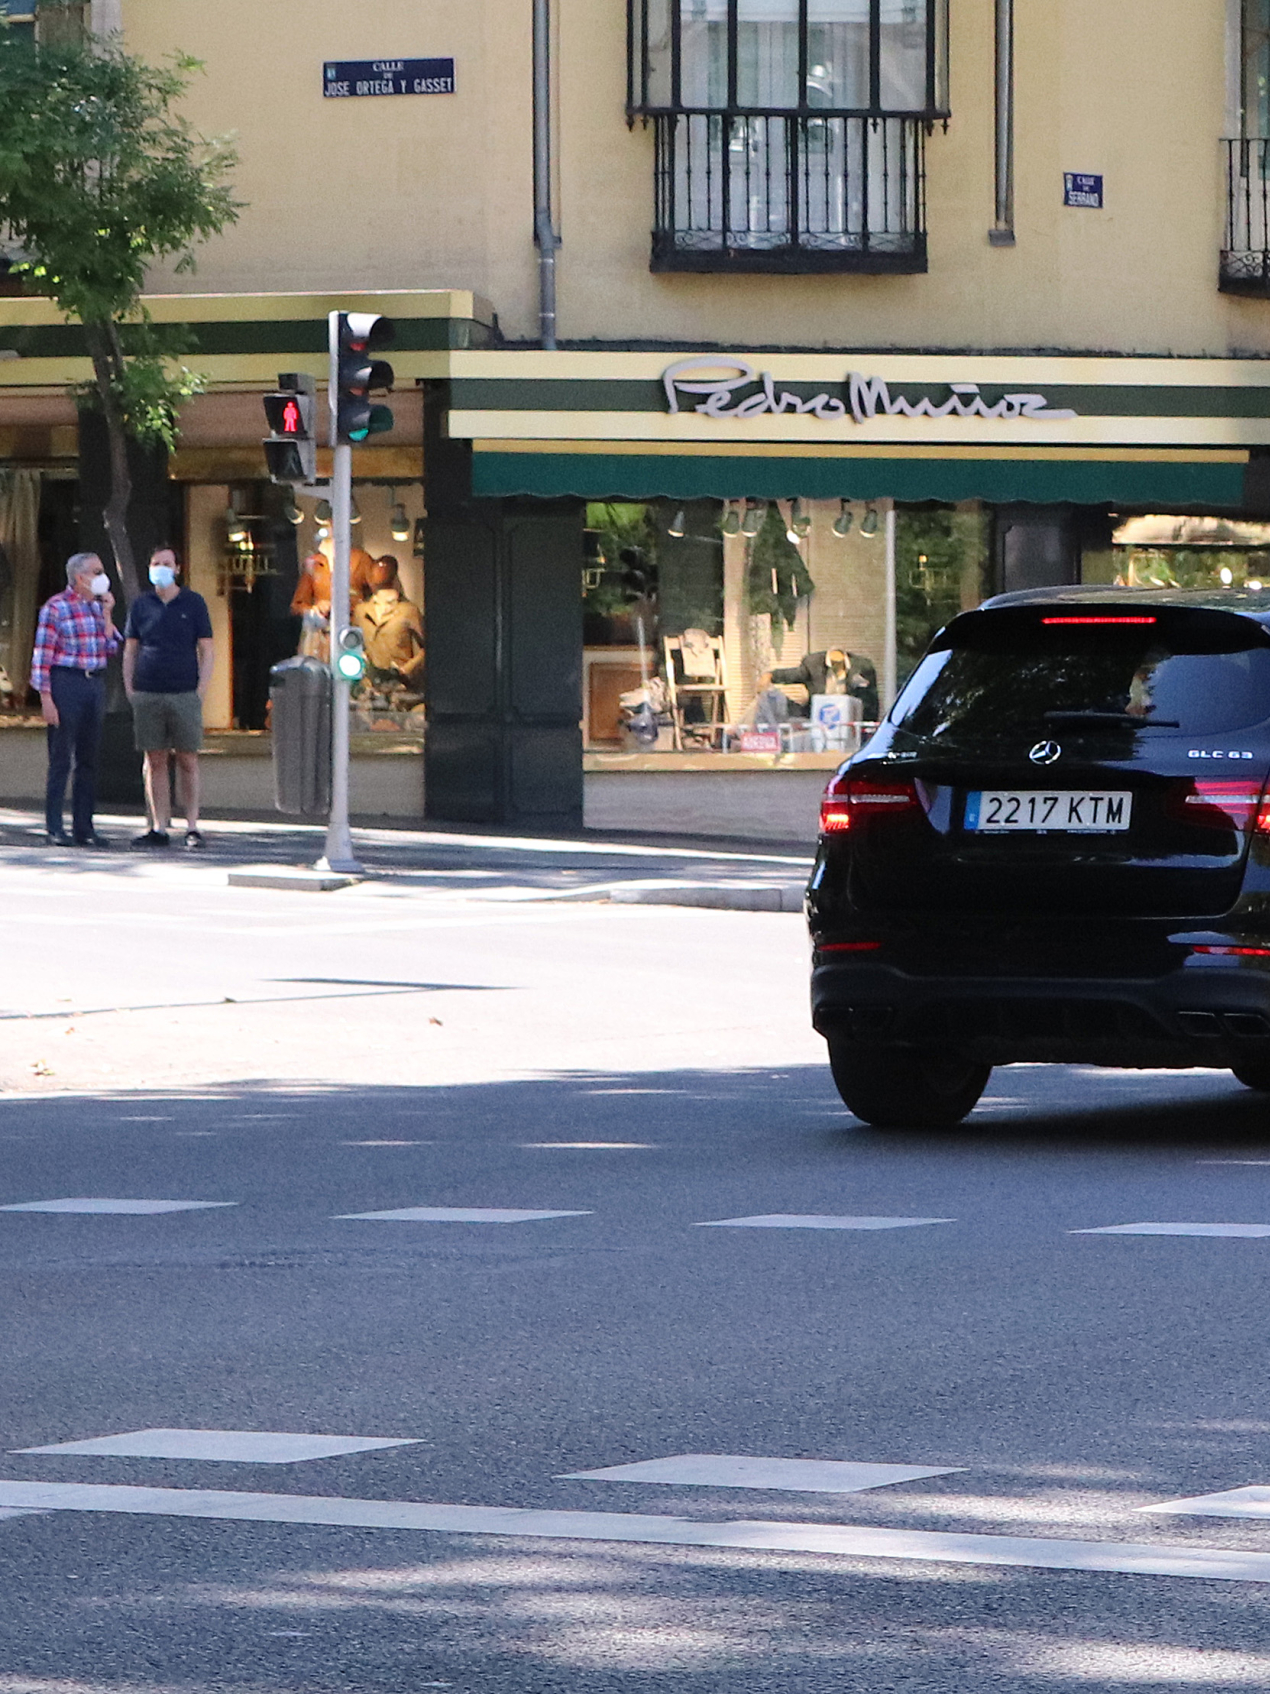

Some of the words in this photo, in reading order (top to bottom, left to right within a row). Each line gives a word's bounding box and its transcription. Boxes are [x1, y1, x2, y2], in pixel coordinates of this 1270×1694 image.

[372, 61, 404, 72] CALLE
[325, 81, 350, 97] JOSE
[355, 79, 395, 95] ORTEGA
[400, 79, 407, 93] Y
[413, 77, 452, 93] GASSET
[1068, 191, 1099, 207] SERRANO
[663, 356, 845, 419] Pedro
[845, 371, 1079, 424] Muñoz
[1187, 749, 1225, 759] GLC
[1227, 750, 1254, 760] 63
[985, 796, 1059, 824] 2217
[1068, 796, 1125, 824] KTM
